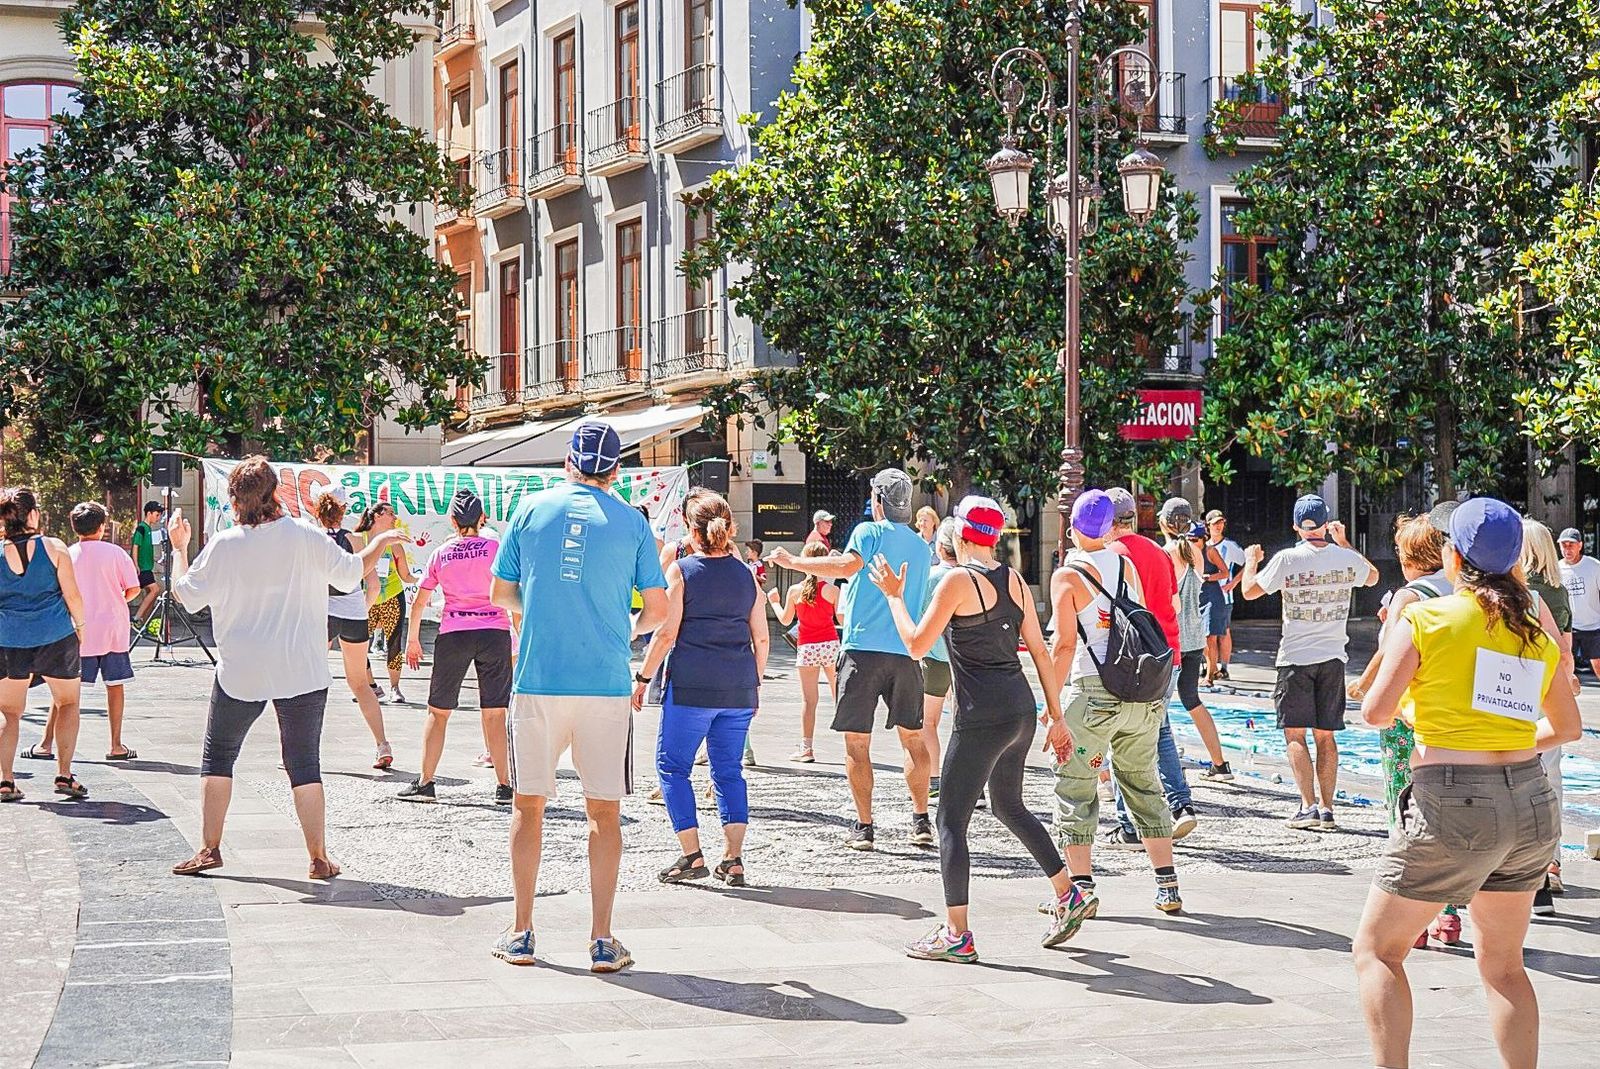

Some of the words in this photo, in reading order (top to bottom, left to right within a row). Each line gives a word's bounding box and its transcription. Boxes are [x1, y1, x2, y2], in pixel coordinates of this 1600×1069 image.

[440, 550, 489, 562] HERBALIFE
[1499, 672, 1512, 681] NO
[1496, 685, 1501, 693] A
[1503, 686, 1512, 695] LA
[1477, 693, 1534, 713] PRIVATIZACIÓN
